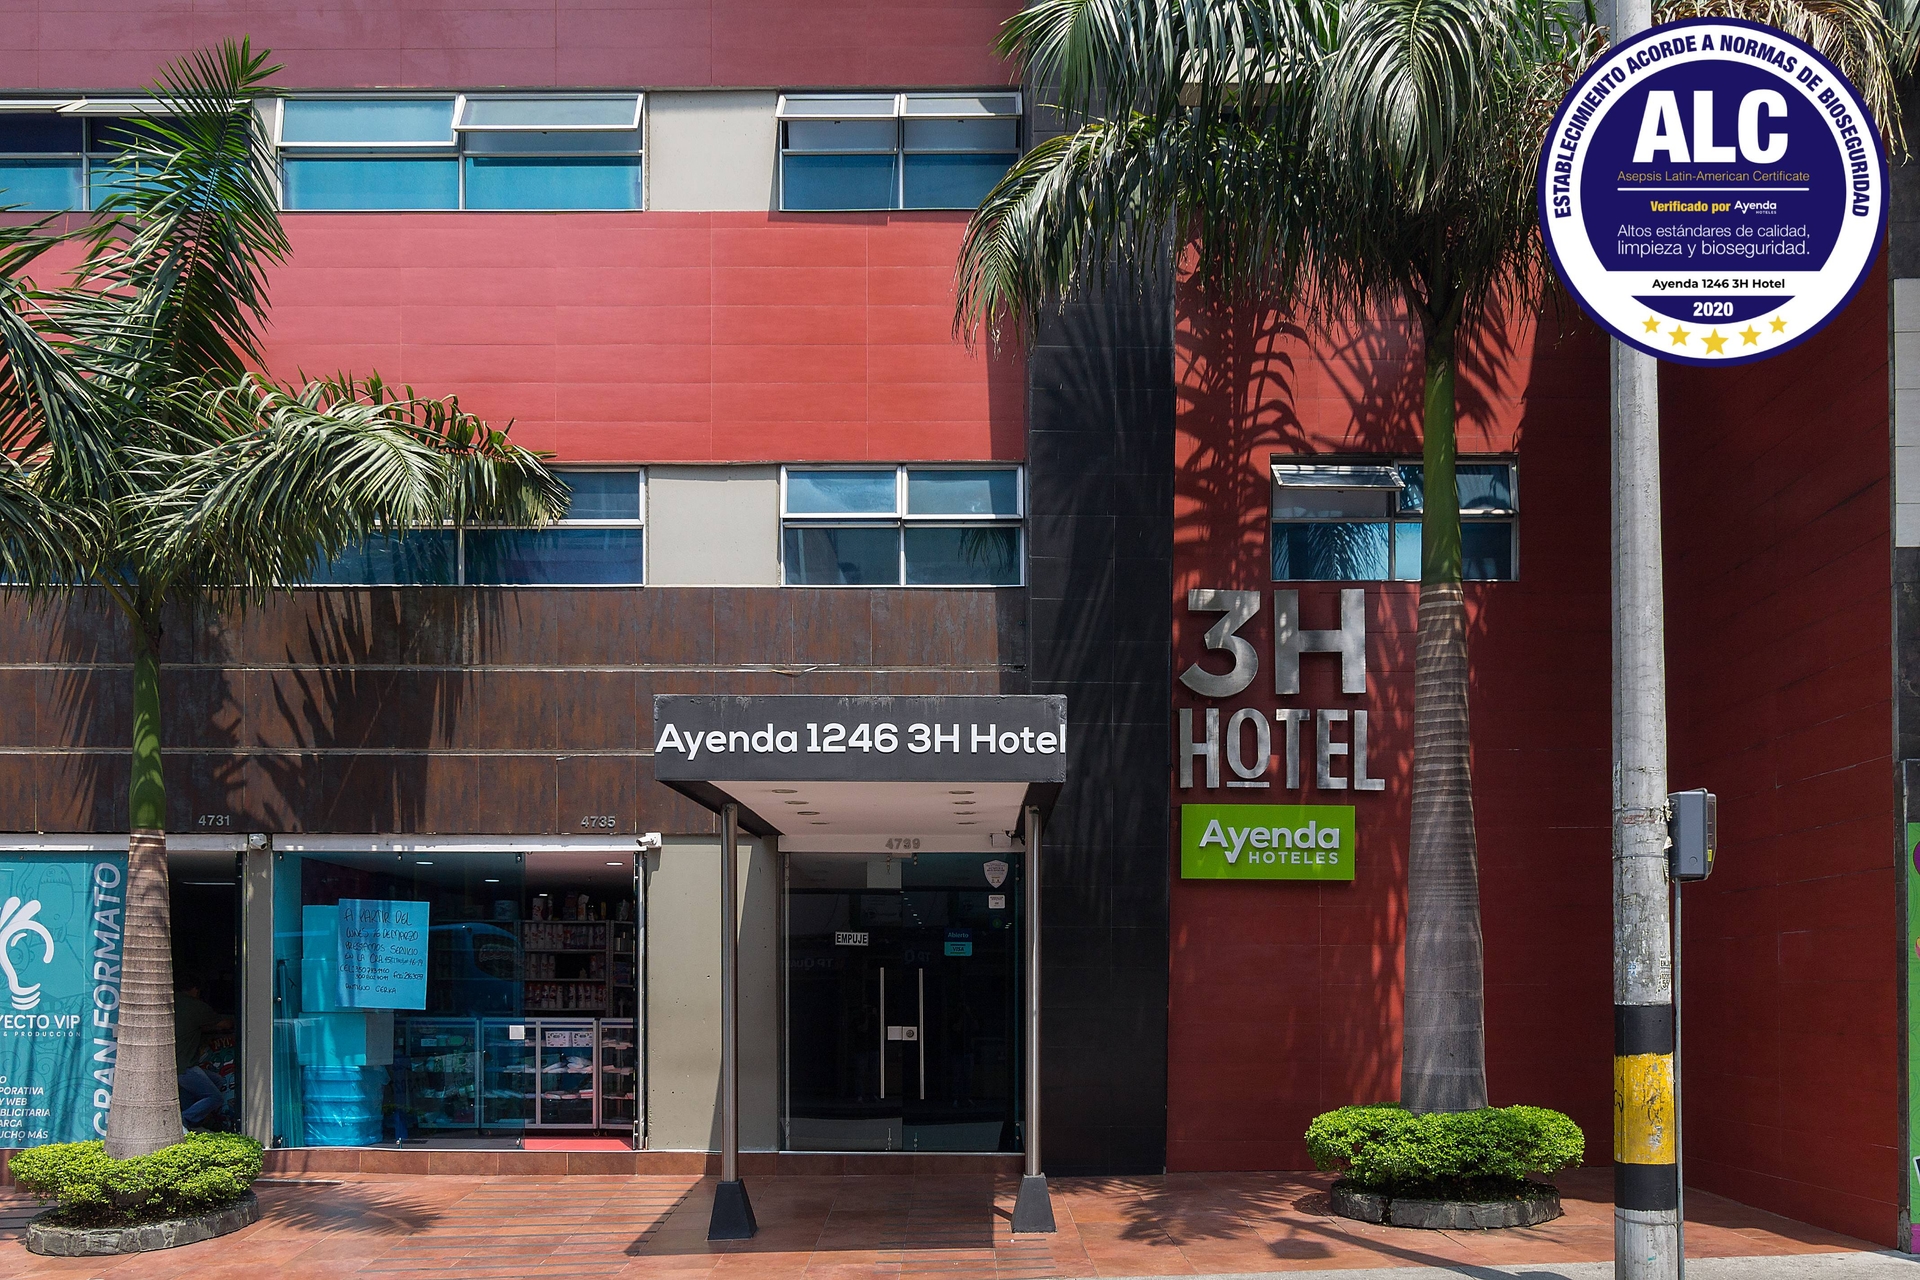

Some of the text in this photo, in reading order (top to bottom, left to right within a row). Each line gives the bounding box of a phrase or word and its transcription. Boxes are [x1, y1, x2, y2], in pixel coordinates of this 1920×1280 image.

[1179, 588, 1366, 697] 3H
[655, 723, 1066, 761] Ayenda 1246 3H Hotel
[1179, 708, 1385, 790] HOTEL
[198, 814, 231, 826] 4731
[581, 816, 616, 828] 4735
[885, 837, 921, 850] 4739
[1199, 819, 1340, 864] Ayenda
[1248, 851, 1339, 865] HOTELES
[344, 908, 412, 926] A PARTIR DEL
[836, 933, 868, 944] EMPUJE
[947, 931, 969, 939] Abierto
[93, 862, 122, 1137] GRAN FORMATO
[54, 1015, 81, 1029] VIP
[6, 1097, 28, 1106] WEB
[27, 1128, 49, 1139] MÁS
